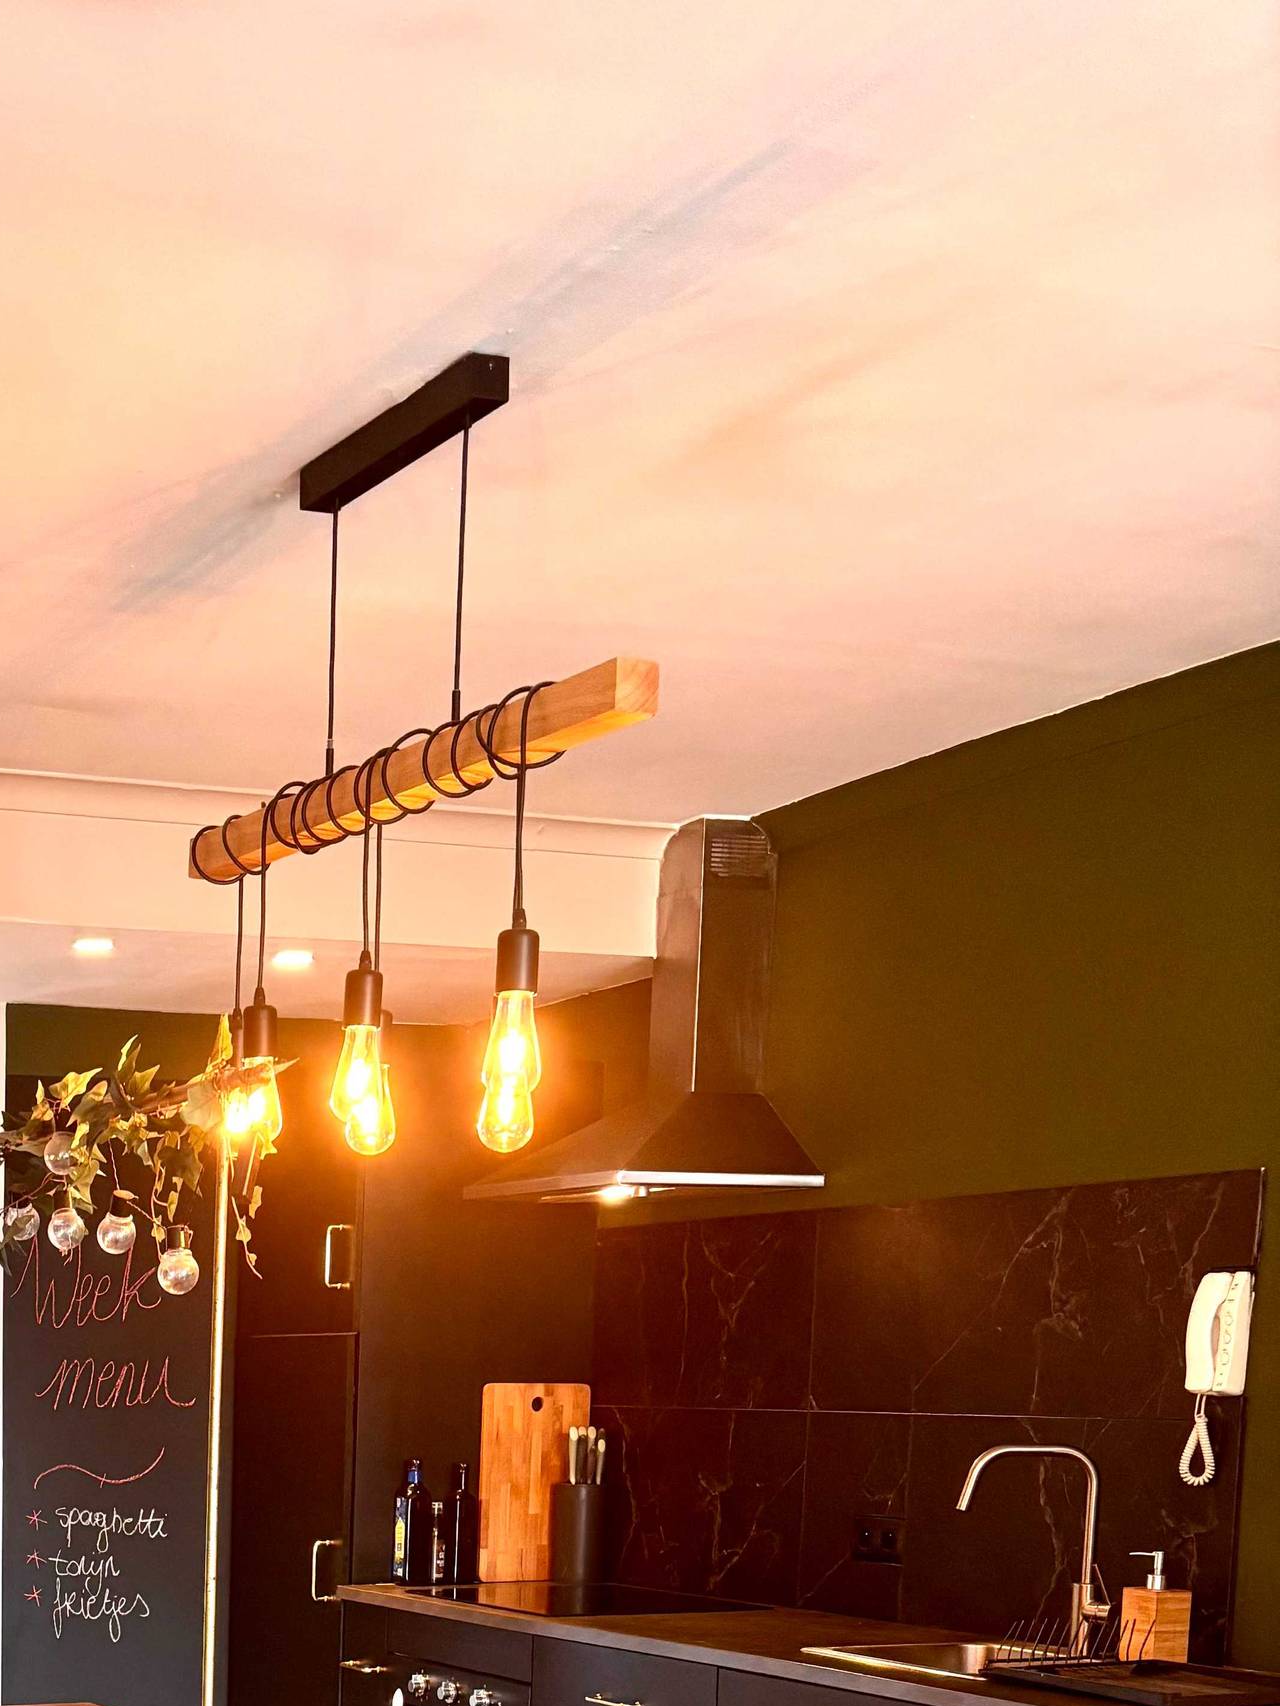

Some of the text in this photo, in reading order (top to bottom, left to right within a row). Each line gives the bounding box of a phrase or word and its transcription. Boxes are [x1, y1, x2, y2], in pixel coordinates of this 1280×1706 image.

[10, 1234, 162, 1329] Week
[34, 1355, 197, 1411] menu
[55, 1506, 168, 1553] spaghetti
